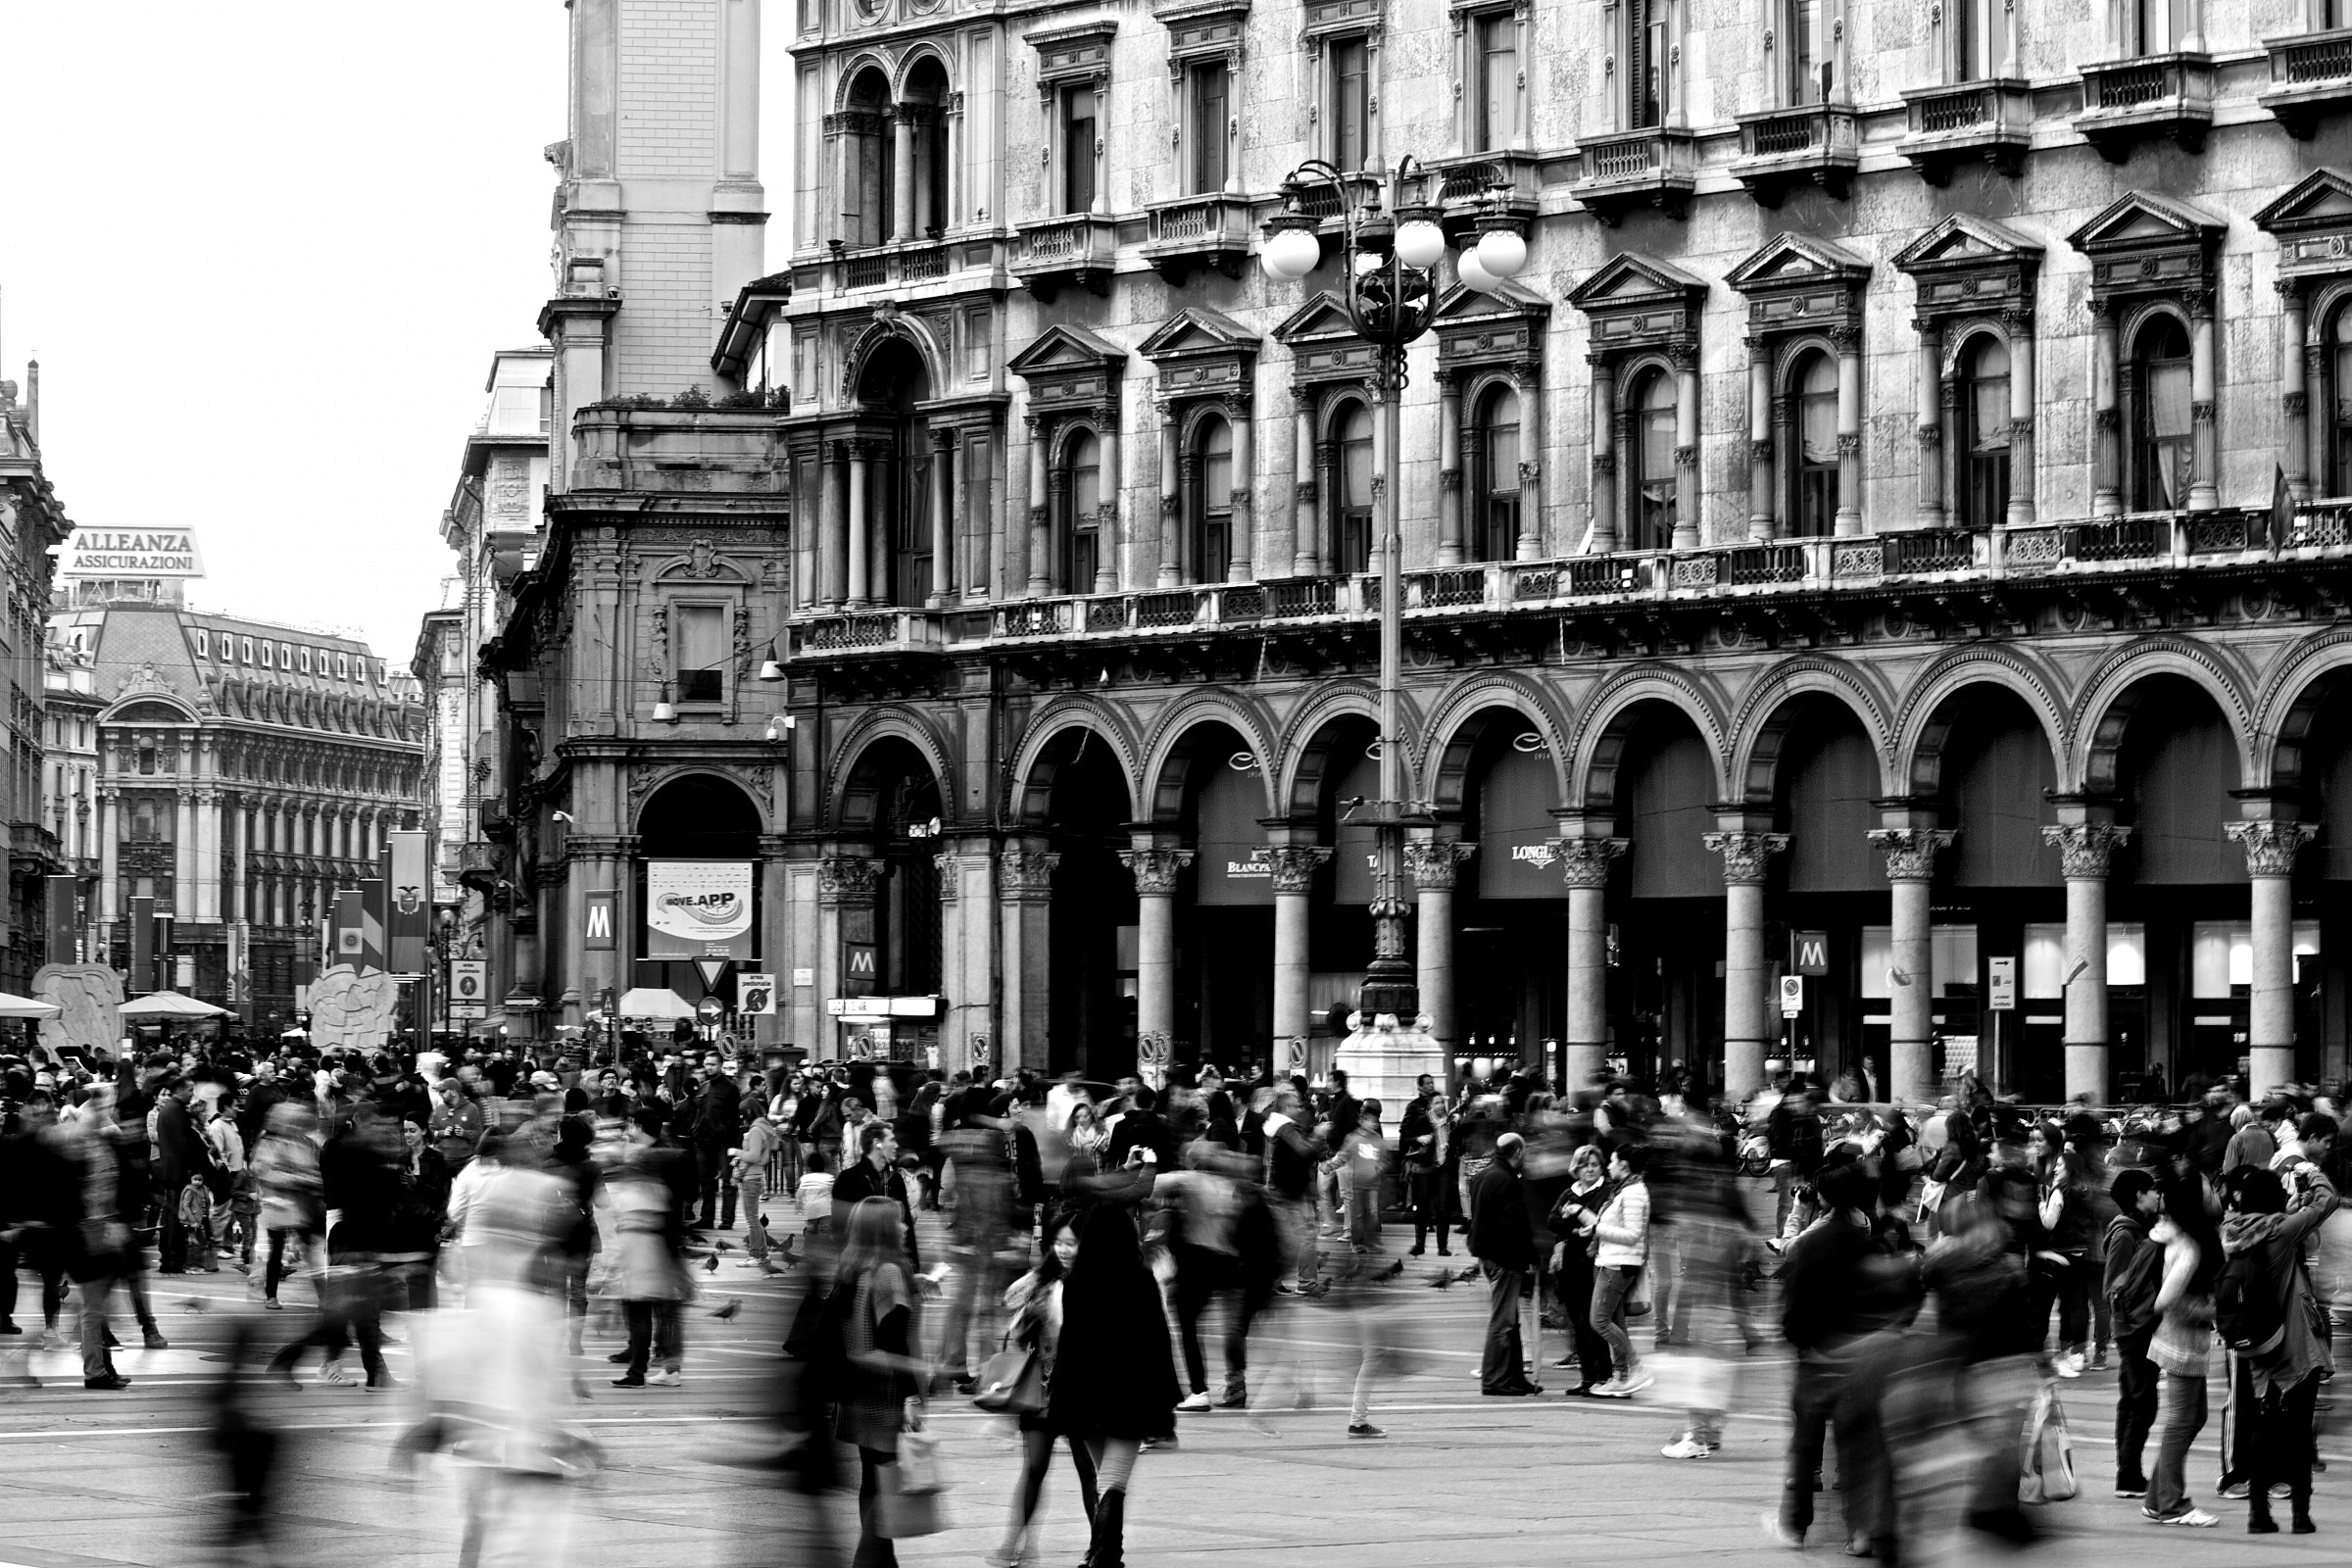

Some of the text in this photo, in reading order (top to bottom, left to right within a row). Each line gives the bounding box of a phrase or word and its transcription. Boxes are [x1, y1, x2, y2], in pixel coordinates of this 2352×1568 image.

[74, 533, 193, 552] ALLEANZA
[74, 555, 193, 569] ASSICURAZIONI
[586, 906, 611, 937] M
[850, 952, 874, 972] M
[1799, 942, 1826, 965] M
